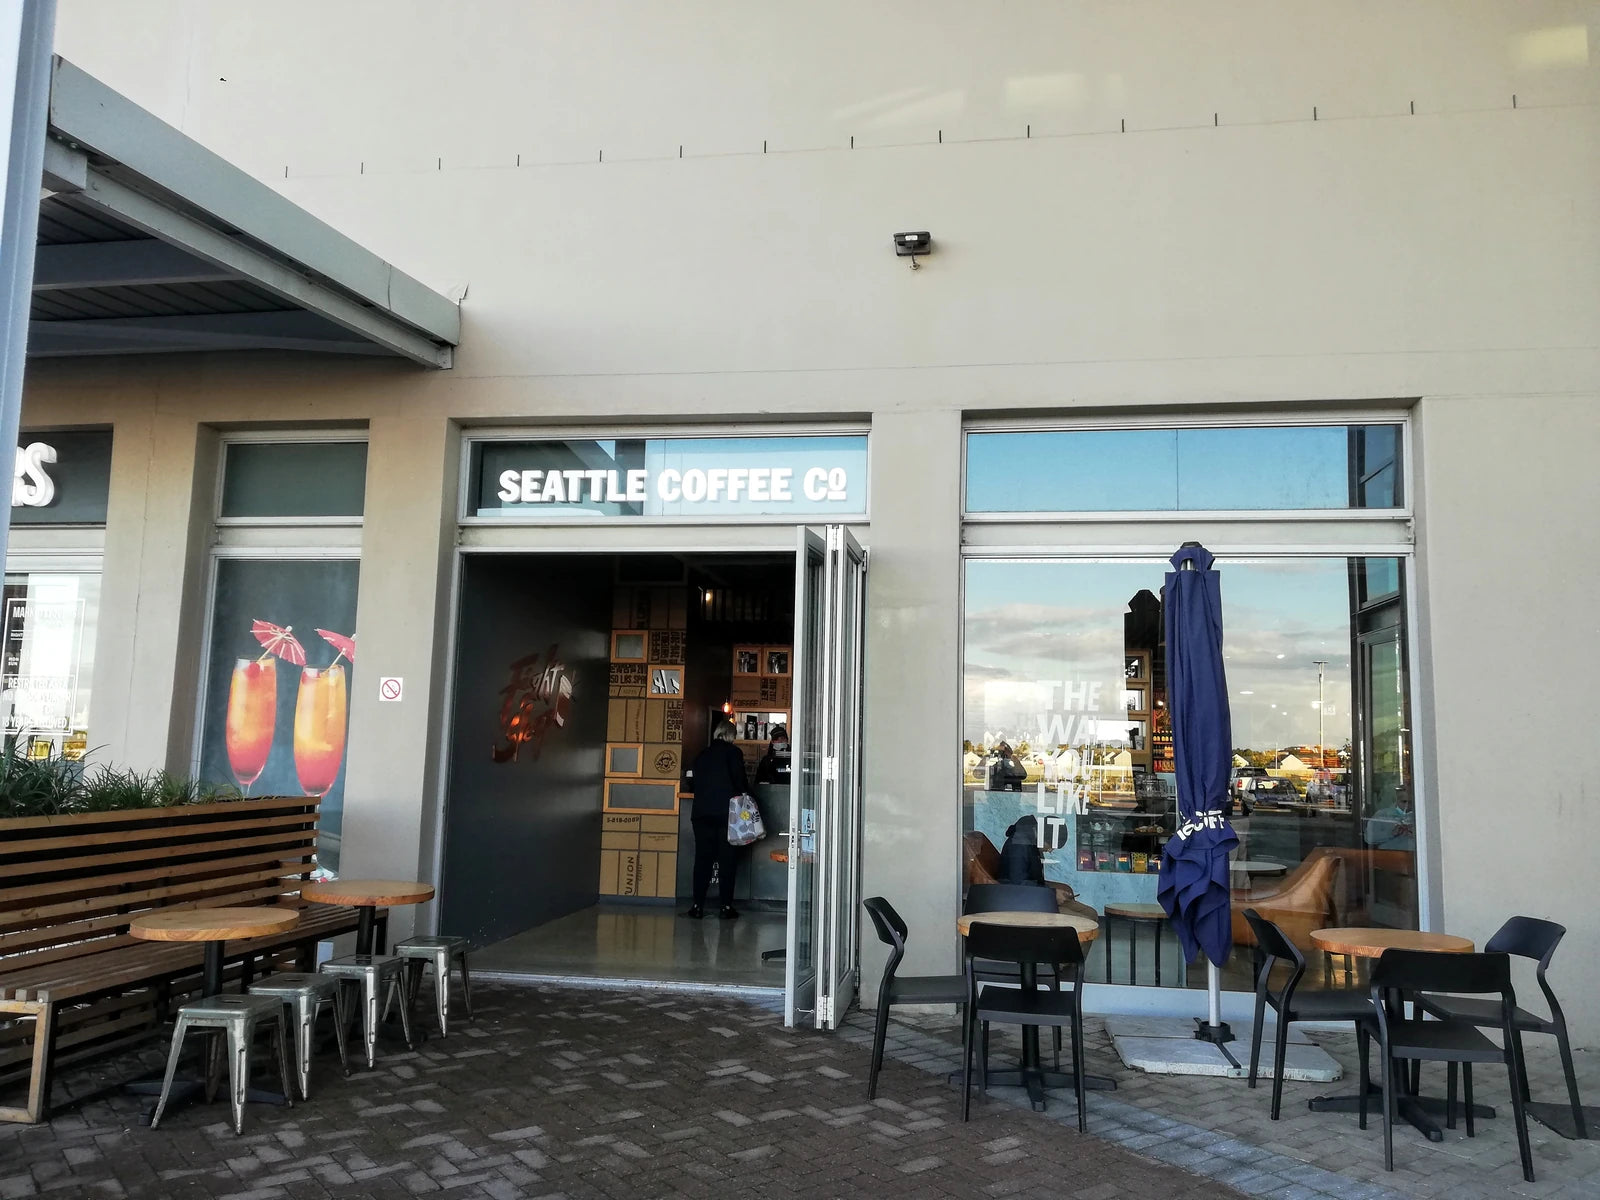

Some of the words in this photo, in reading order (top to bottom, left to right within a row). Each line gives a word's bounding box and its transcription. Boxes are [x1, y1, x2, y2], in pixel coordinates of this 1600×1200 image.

[498, 469, 648, 503] SEATTLE
[657, 468, 793, 502] COFFEE
[1037, 680, 1102, 711] THE
[1037, 782, 1092, 815] LIKE
[1036, 817, 1066, 849] IT
